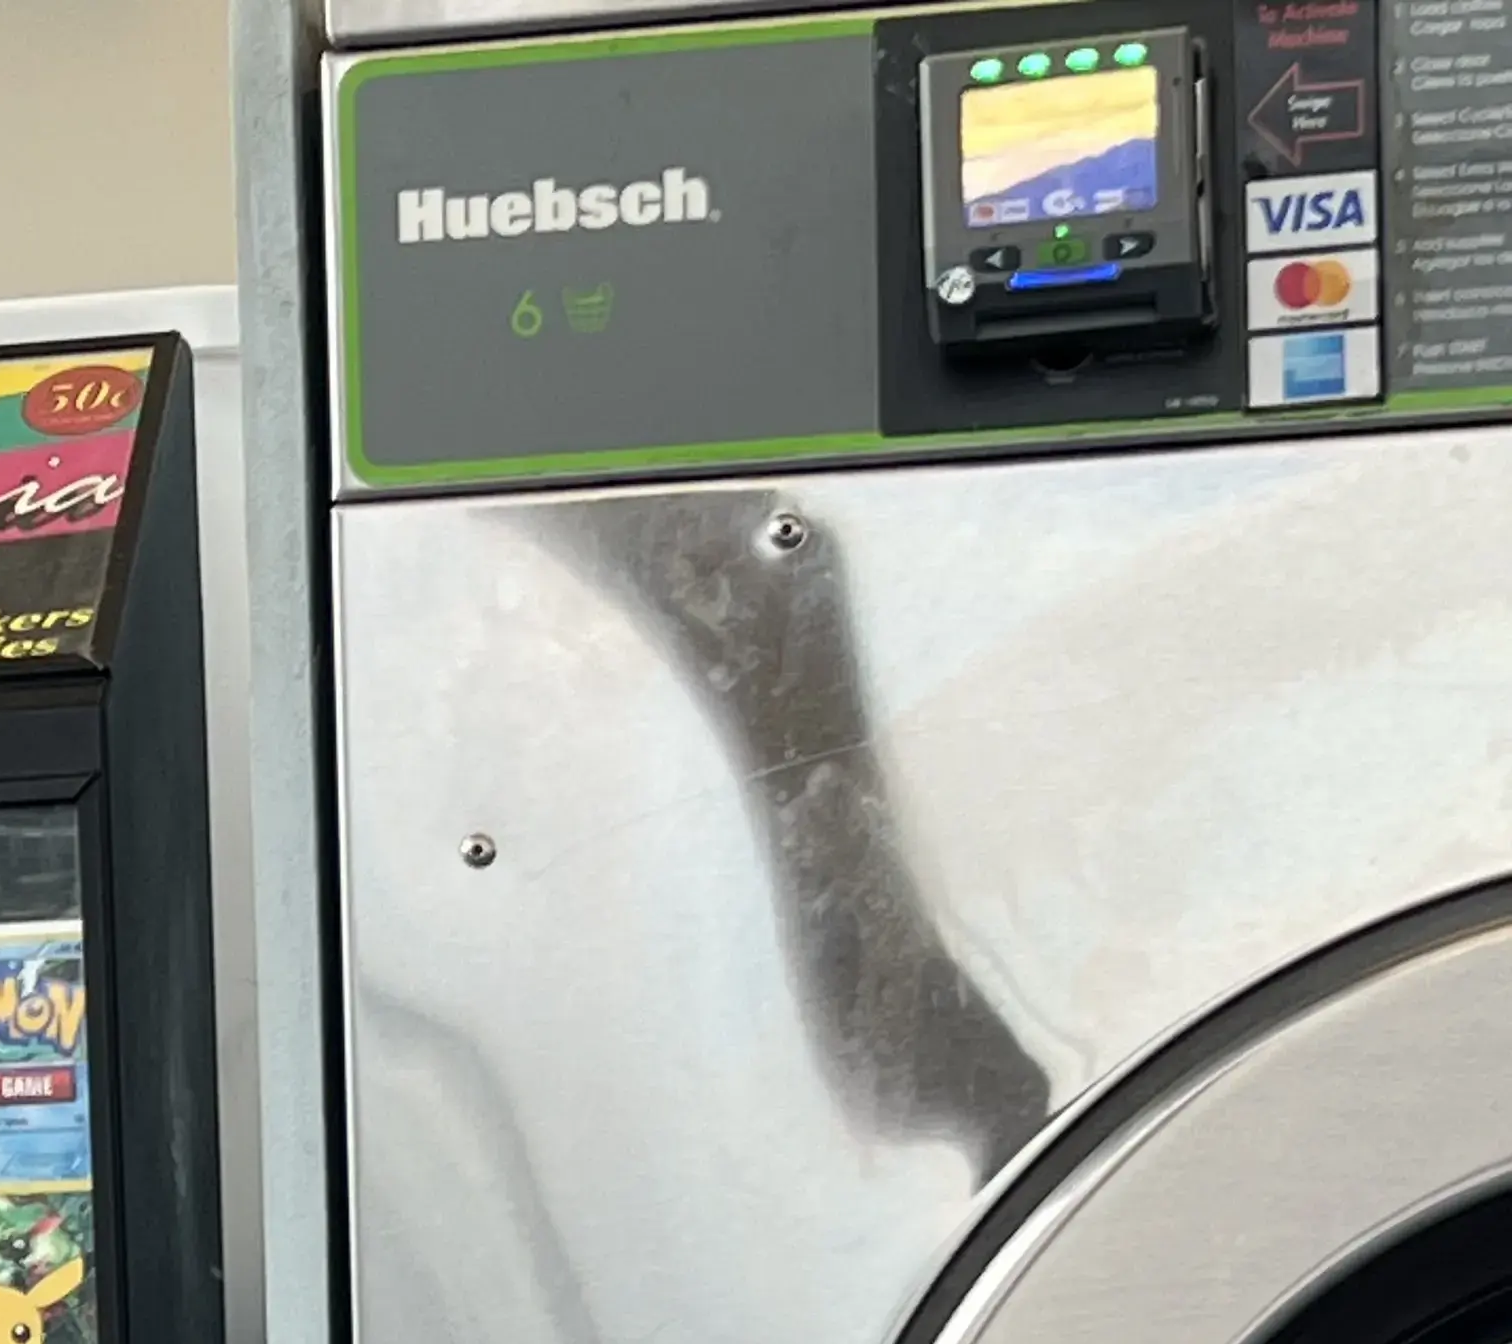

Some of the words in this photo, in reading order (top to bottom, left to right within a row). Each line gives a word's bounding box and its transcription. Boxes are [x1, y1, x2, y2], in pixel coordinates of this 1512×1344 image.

[398, 166, 709, 244] Huebsch
[1252, 188, 1365, 235] VISA
[510, 288, 544, 338] 6
[1, 1073, 53, 1098] GAME
